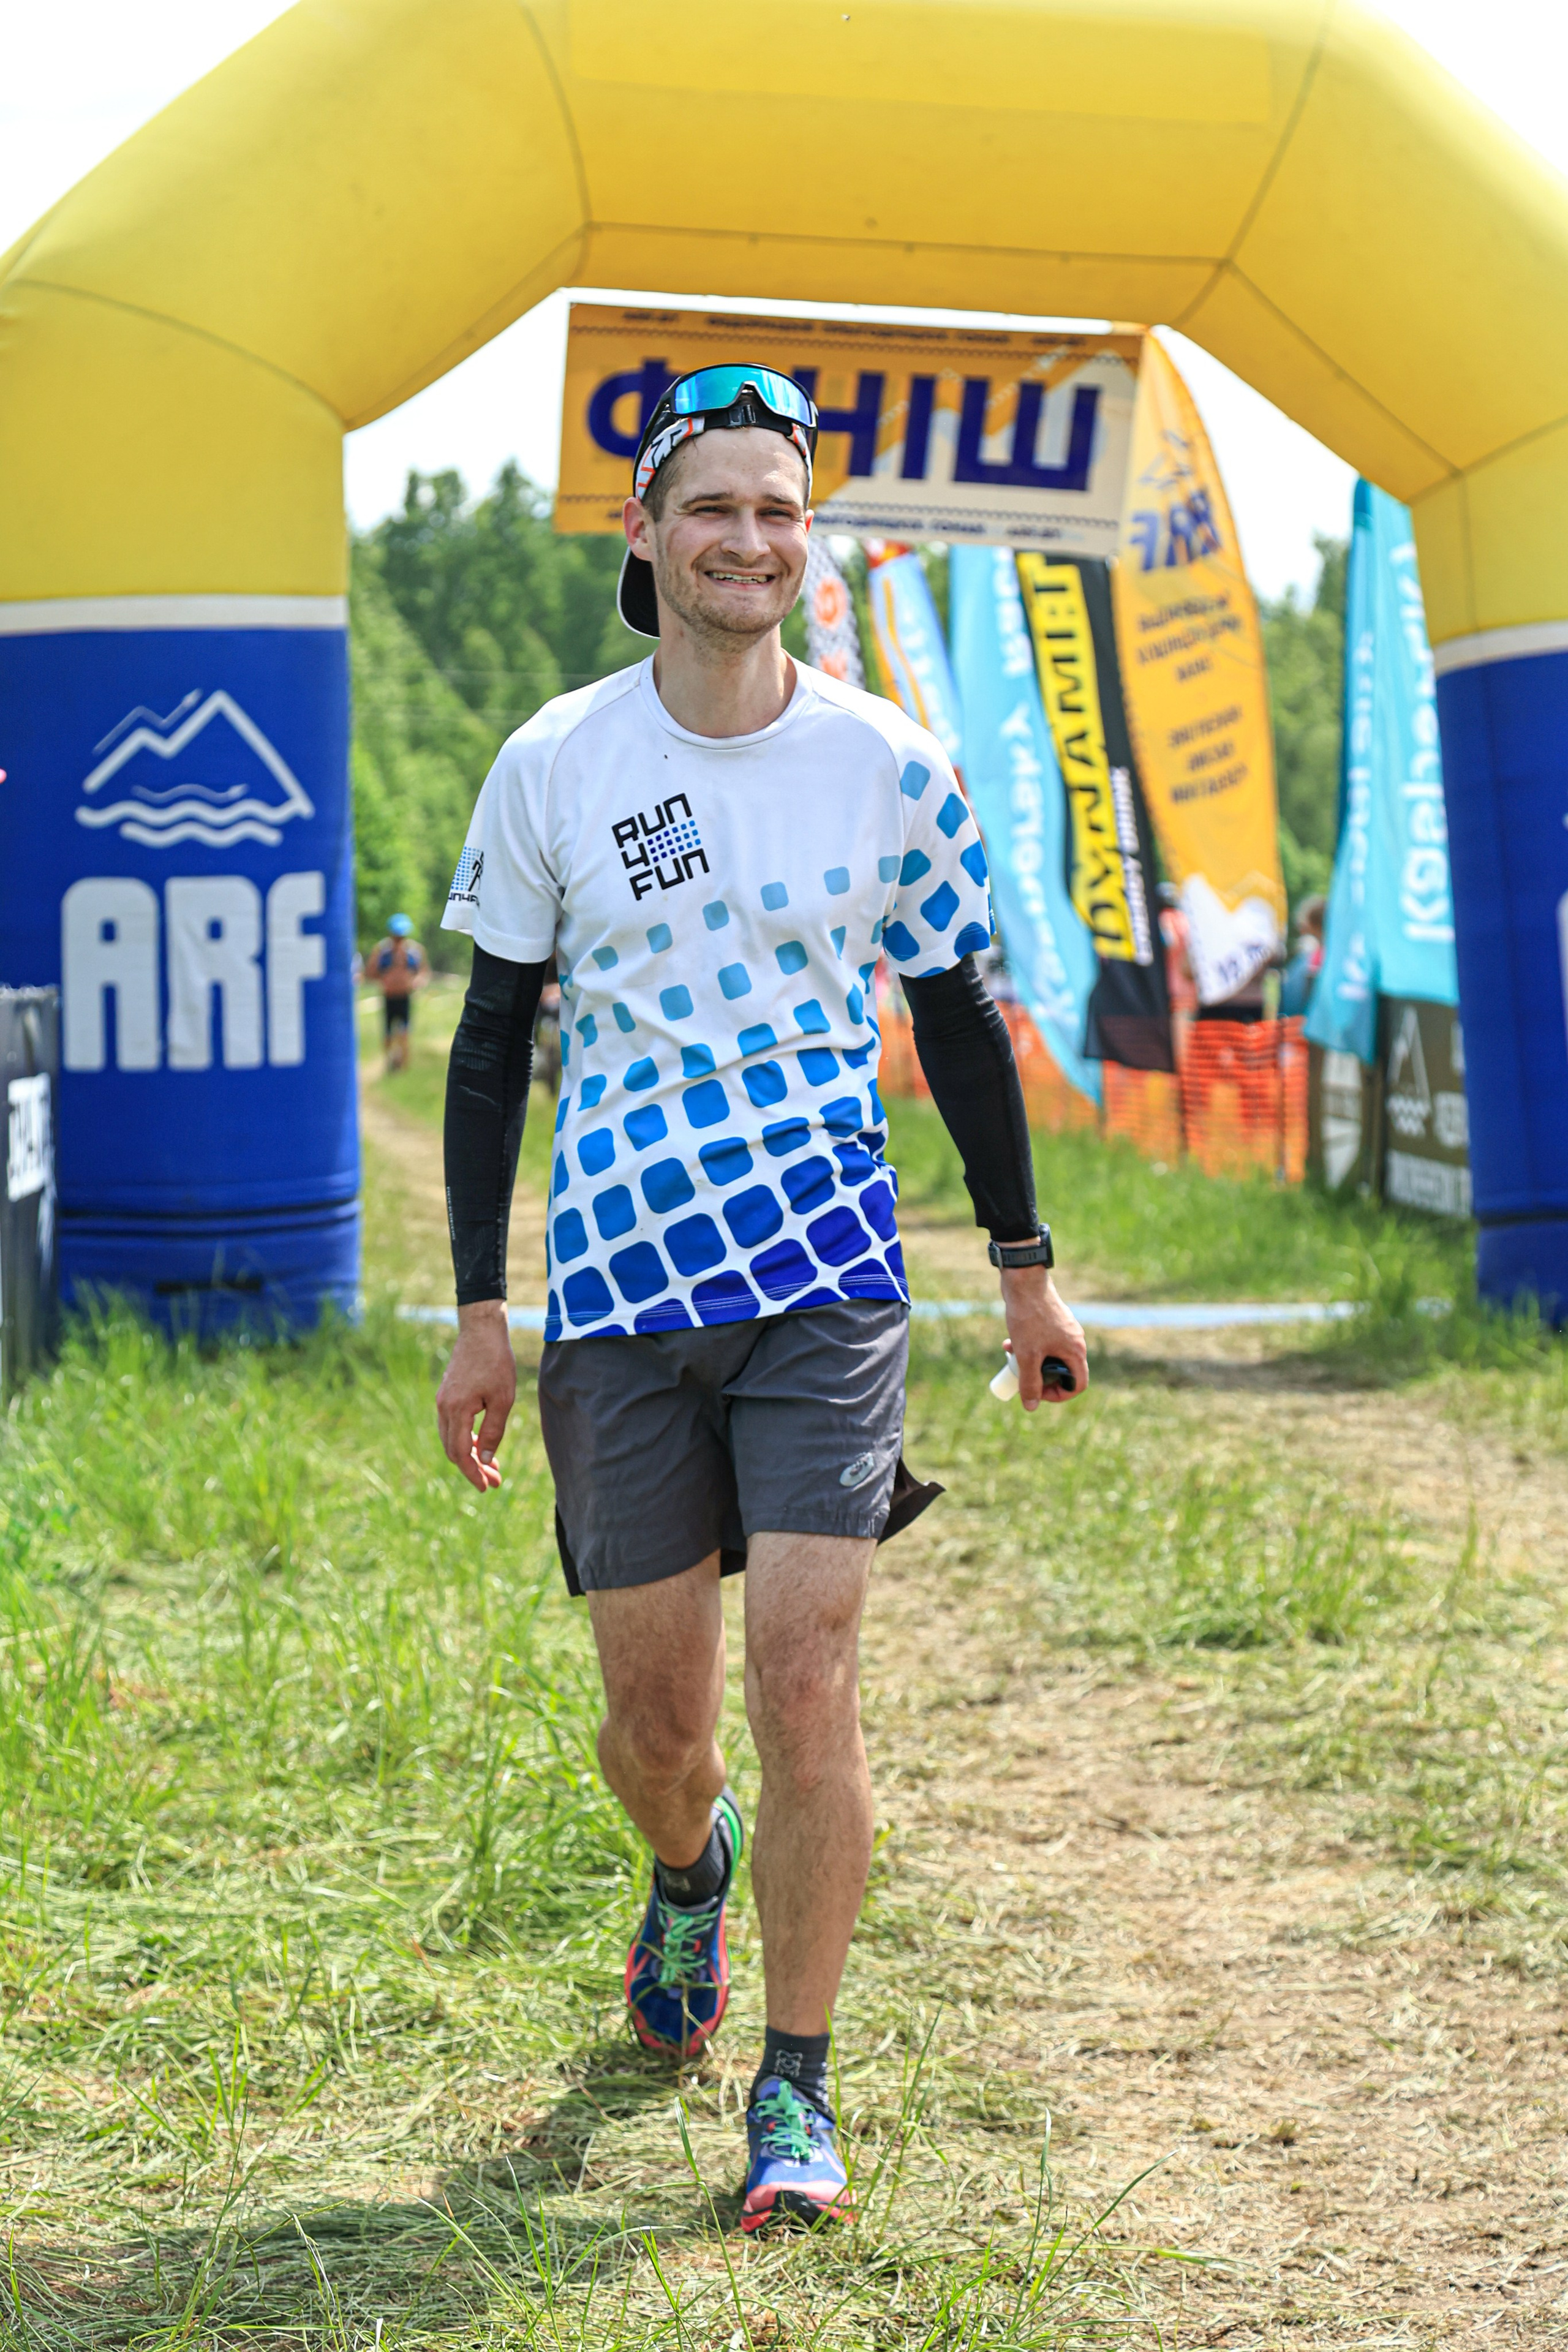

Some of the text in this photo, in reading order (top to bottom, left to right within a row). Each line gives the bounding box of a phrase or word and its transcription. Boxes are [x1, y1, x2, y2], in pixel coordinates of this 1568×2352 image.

[586, 355, 1101, 491] ФНІШ
[612, 793, 692, 848] RUN
[620, 843, 650, 869] 4
[629, 848, 710, 901] FUN
[61, 870, 326, 1072] ARF
